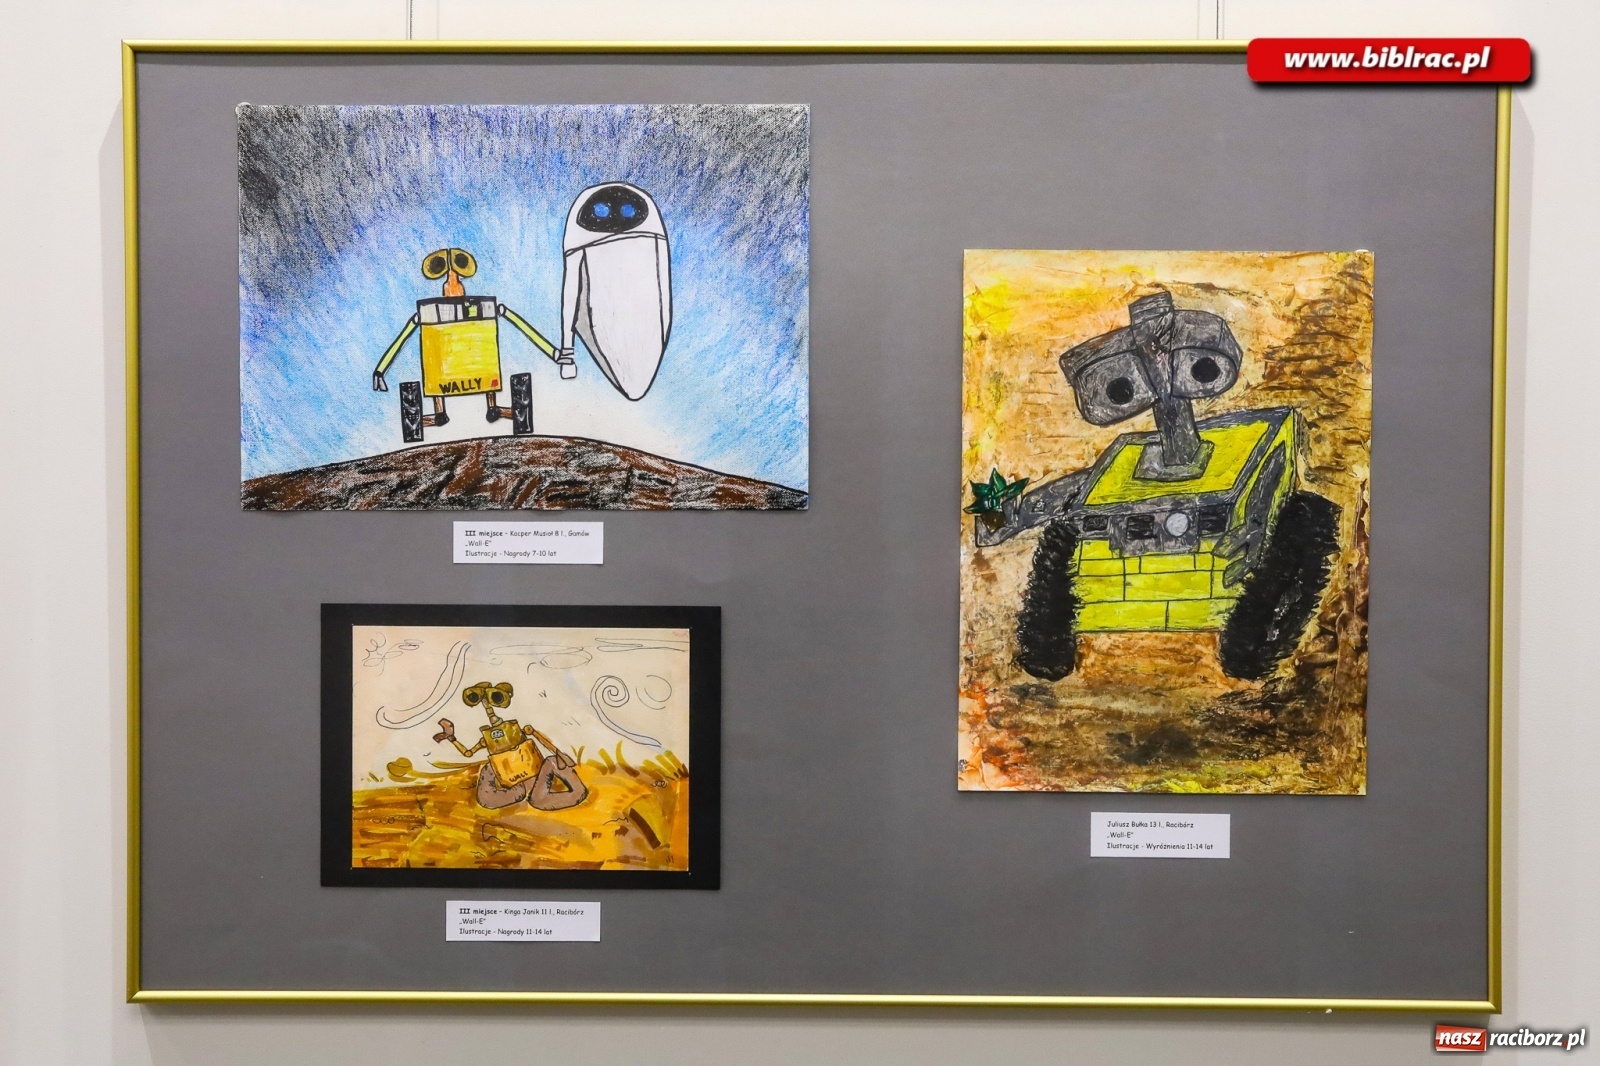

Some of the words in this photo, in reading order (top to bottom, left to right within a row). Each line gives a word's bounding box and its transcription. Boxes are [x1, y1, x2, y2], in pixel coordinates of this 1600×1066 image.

[440, 378, 482, 394] WALLY
[478, 530, 503, 538] miejsce
[509, 530, 531, 538] Kacper
[465, 550, 497, 559] Ilustracje
[503, 550, 530, 559] Nagrody
[1165, 821, 1194, 829] Racibórz
[1106, 842, 1139, 851] Ilustracje
[1145, 842, 1185, 851] Wyróżnienia
[472, 908, 498, 917] miejsce
[504, 908, 521, 917] Kinga
[556, 908, 585, 916] Racibórz
[459, 928, 492, 936] Ilustracje
[497, 928, 524, 937] Nagrody
[543, 928, 553, 936] lat
